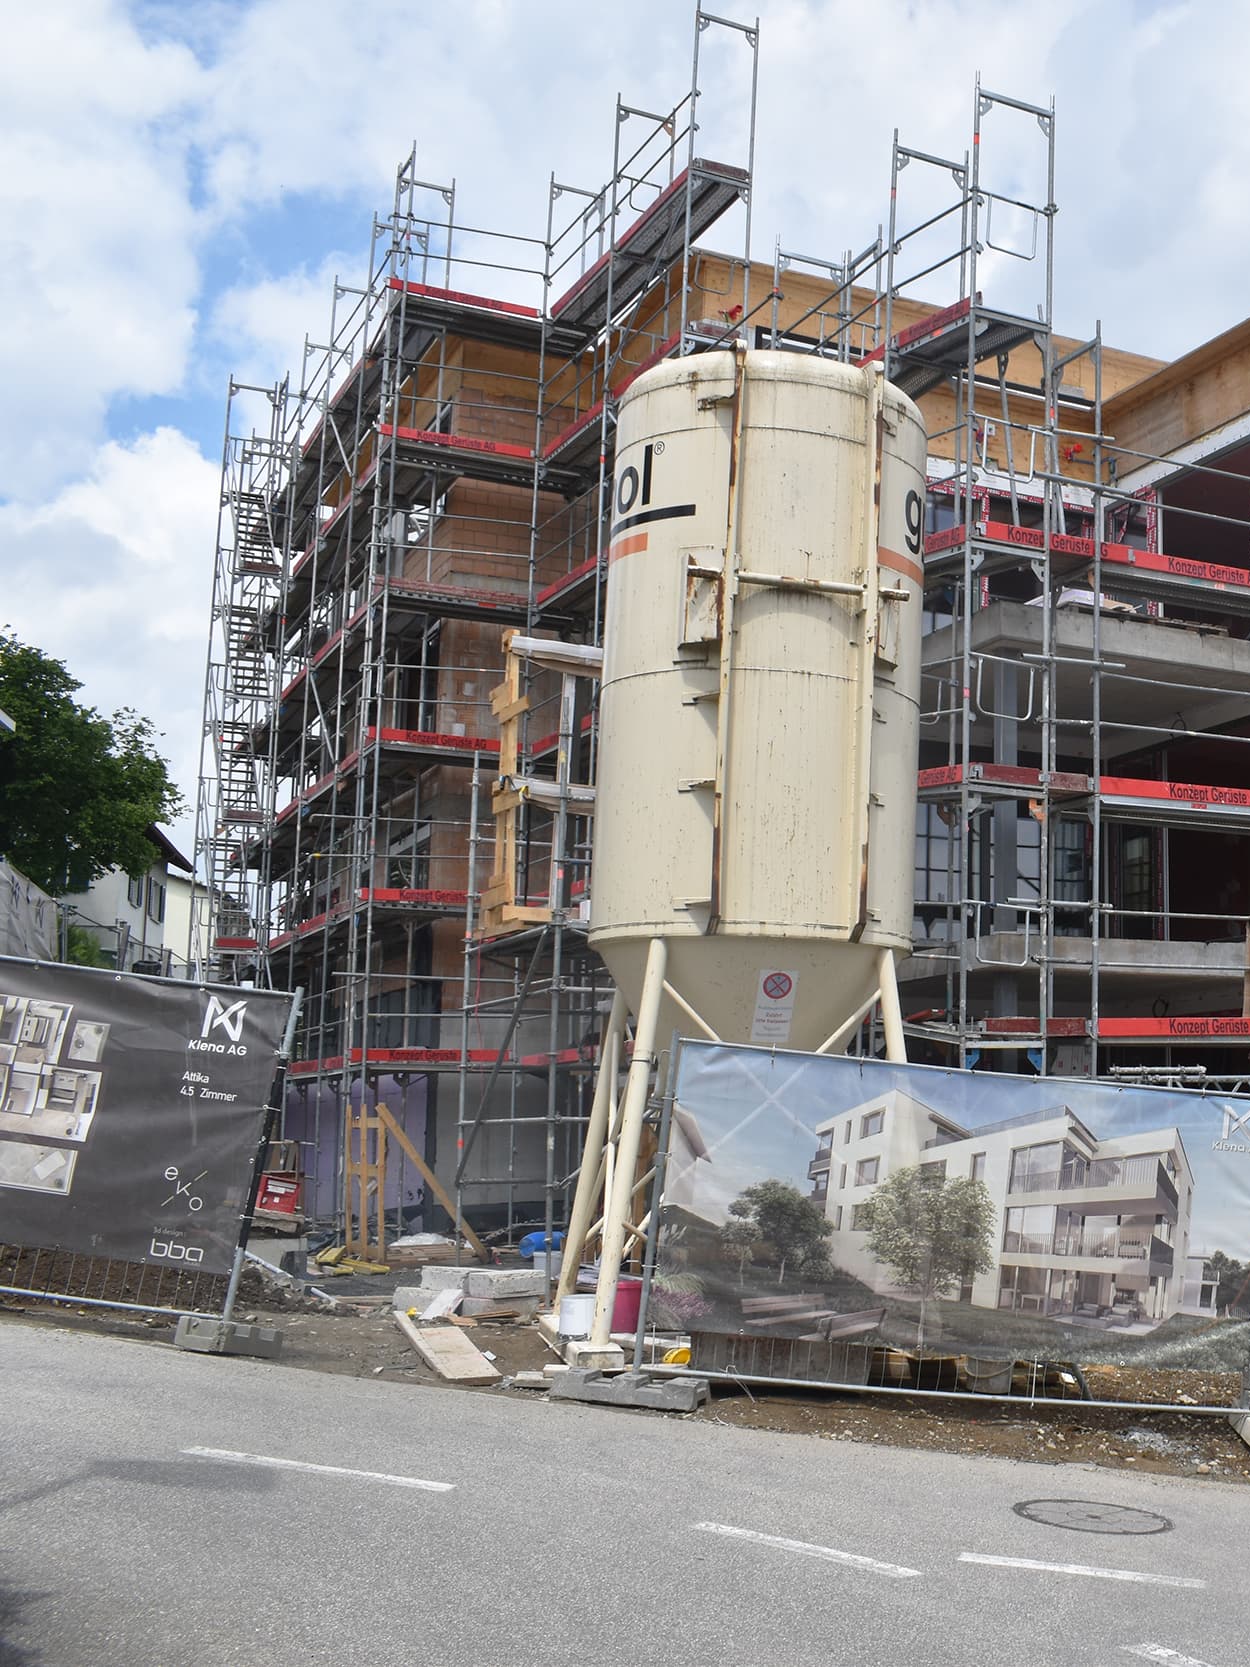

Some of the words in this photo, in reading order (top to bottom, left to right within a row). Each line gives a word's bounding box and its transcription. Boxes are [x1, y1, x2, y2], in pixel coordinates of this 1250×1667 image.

[1008, 525, 1045, 547] Konzep
[1168, 557, 1207, 577] Konzept
[1169, 783, 1209, 801] Konzept
[1169, 1018, 1210, 1036] Konzept
[188, 1039, 226, 1054] Klena
[227, 1044, 248, 1057] AG
[182, 1070, 210, 1084] Attika
[200, 1087, 238, 1102] Zimmer
[1212, 1140, 1246, 1153] Klena
